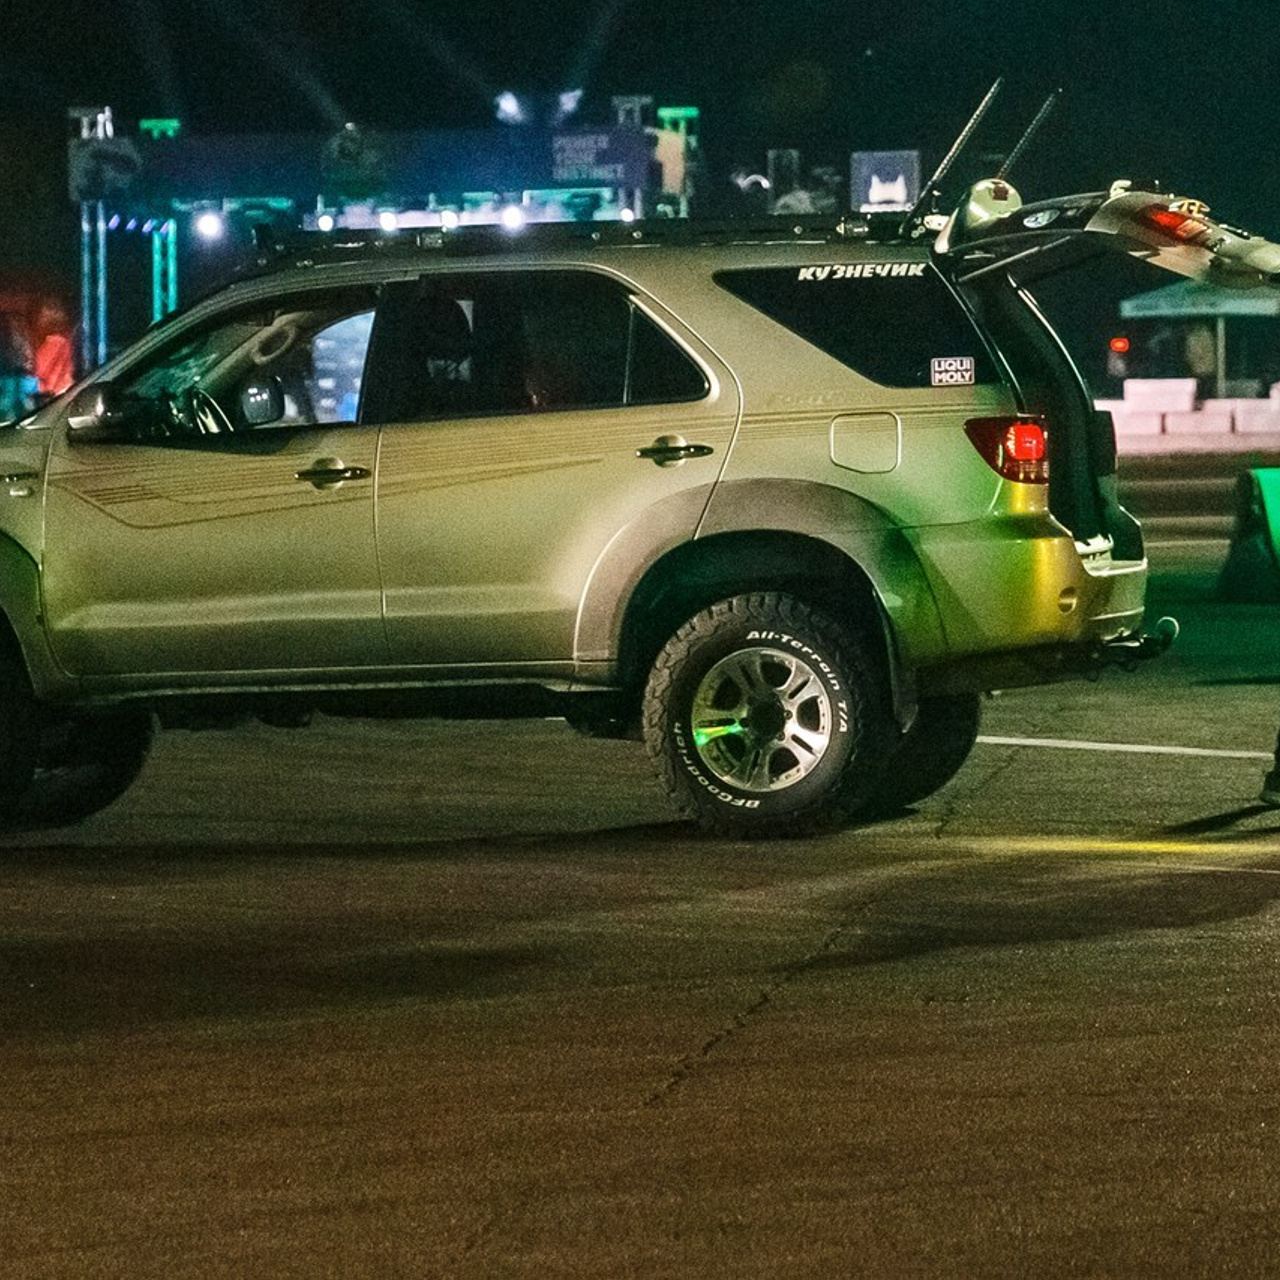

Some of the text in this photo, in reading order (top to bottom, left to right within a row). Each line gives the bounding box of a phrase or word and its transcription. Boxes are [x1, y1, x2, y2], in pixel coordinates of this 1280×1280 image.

[797, 263, 927, 281] КУЗНЕЧИК
[934, 359, 972, 372] LIQUI
[934, 371, 972, 384] MOLY
[745, 629, 850, 733] All-Terrain T/A
[673, 721, 761, 810] BFGoodrich
